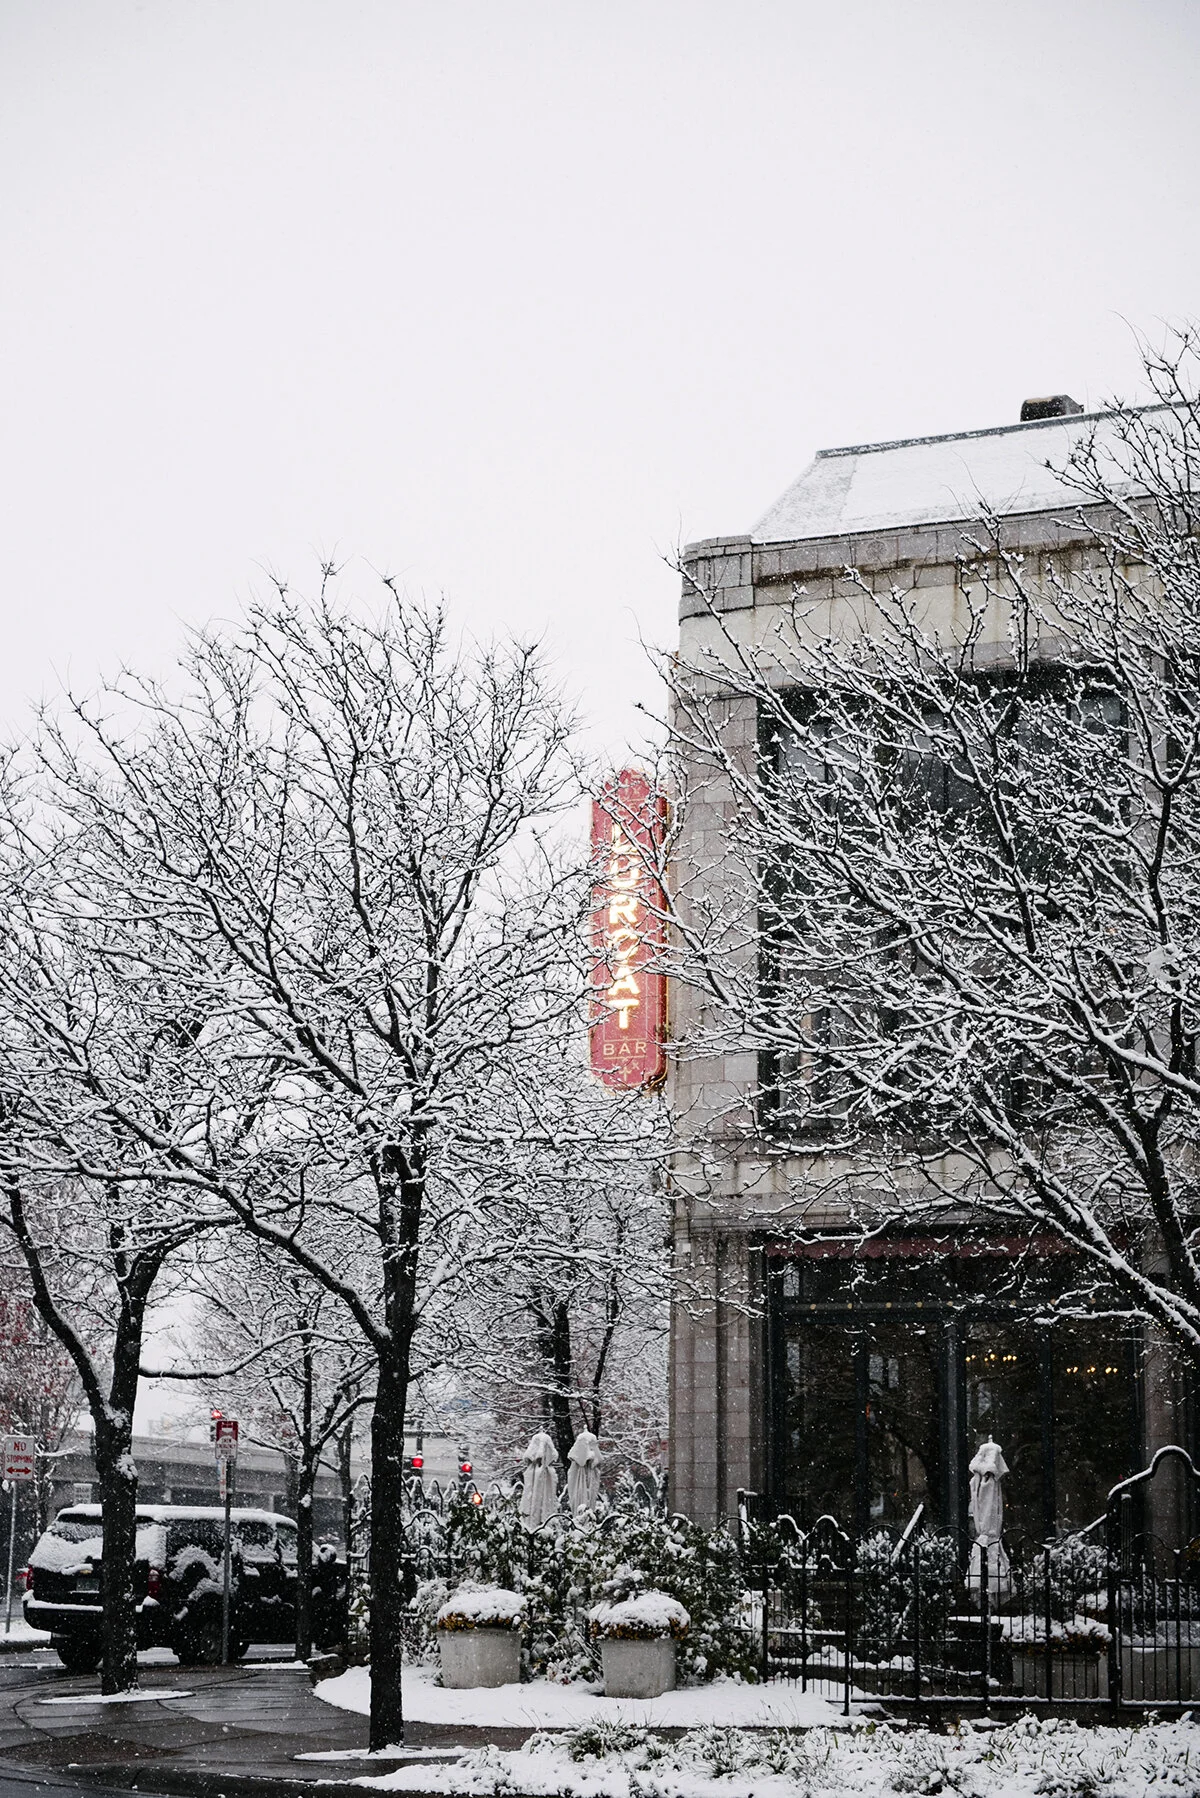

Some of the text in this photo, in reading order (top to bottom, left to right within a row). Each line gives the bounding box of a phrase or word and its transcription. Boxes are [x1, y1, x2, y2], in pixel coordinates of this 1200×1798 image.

[603, 1041, 647, 1056] BAR
[13, 1440, 27, 1451] NO
[6, 1454, 33, 1463] STOPPING
